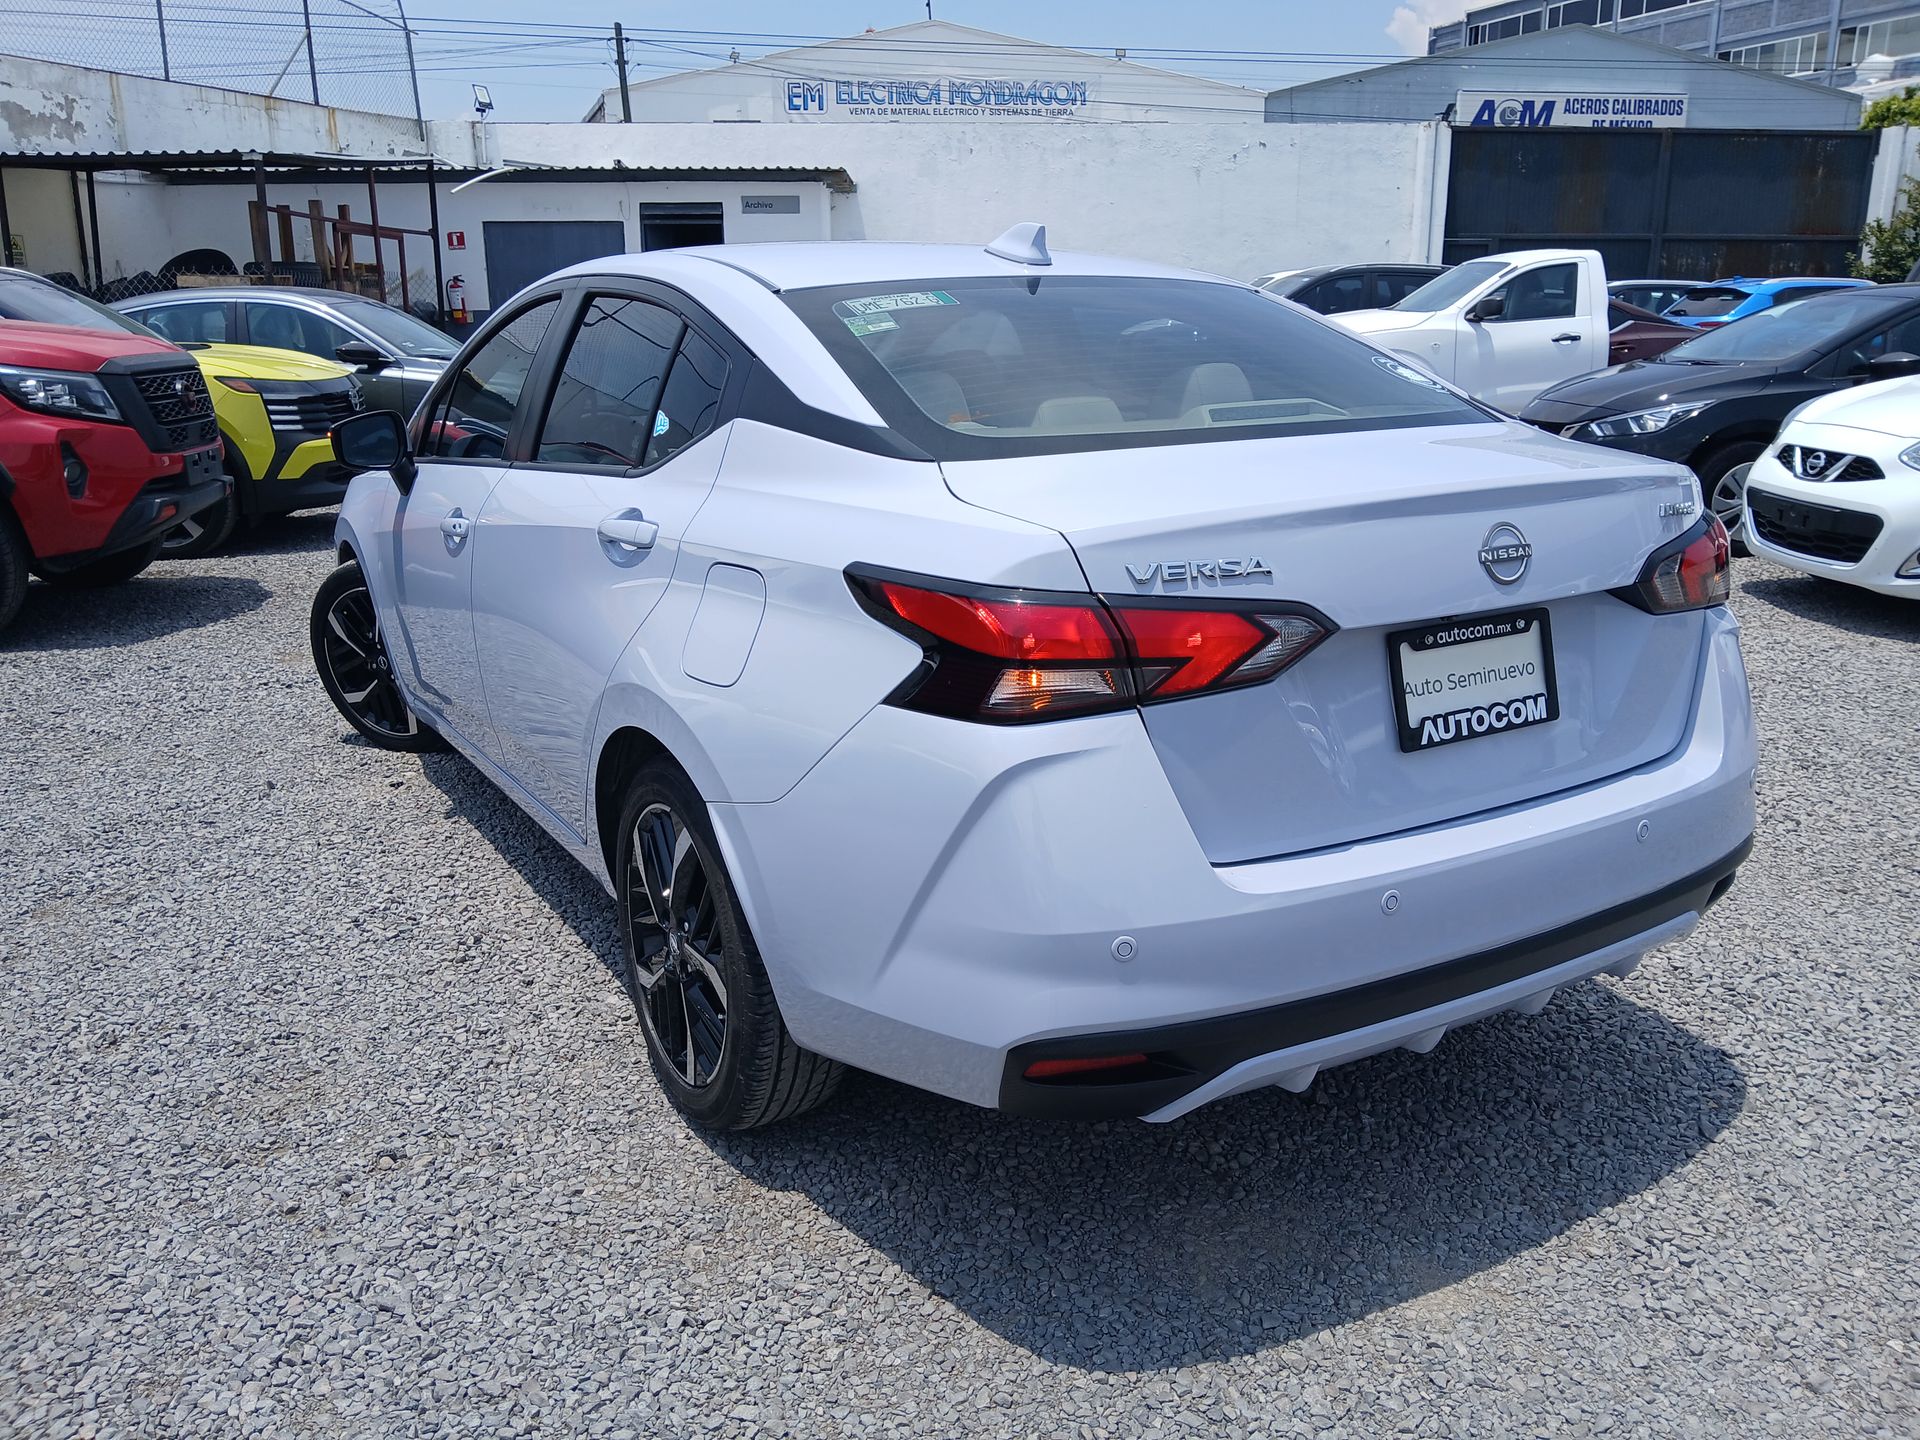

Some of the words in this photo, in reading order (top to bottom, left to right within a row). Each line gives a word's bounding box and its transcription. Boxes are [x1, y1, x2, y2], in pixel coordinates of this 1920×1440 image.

[787, 82, 824, 111] EM
[1563, 98, 1610, 115] ACEROS
[1612, 99, 1684, 116] CALIBRADOS
[849, 107, 876, 116] VENTA
[878, 108, 889, 116] DE
[891, 108, 931, 116] MATERIAL
[980, 108, 986, 116] Y
[989, 108, 1029, 116] SISTEMAS
[1031, 108, 1043, 116] DE
[1045, 108, 1074, 116] TIERRA
[744, 200, 774, 209] Archivo
[1481, 546, 1532, 562] NISSAN
[1125, 555, 1273, 584] VERSA
[1436, 622, 1512, 644] autocom.mx
[1404, 678, 1443, 698] Auto
[1447, 661, 1535, 691] Seminuevo
[1421, 696, 1548, 746] AUTOCOM
